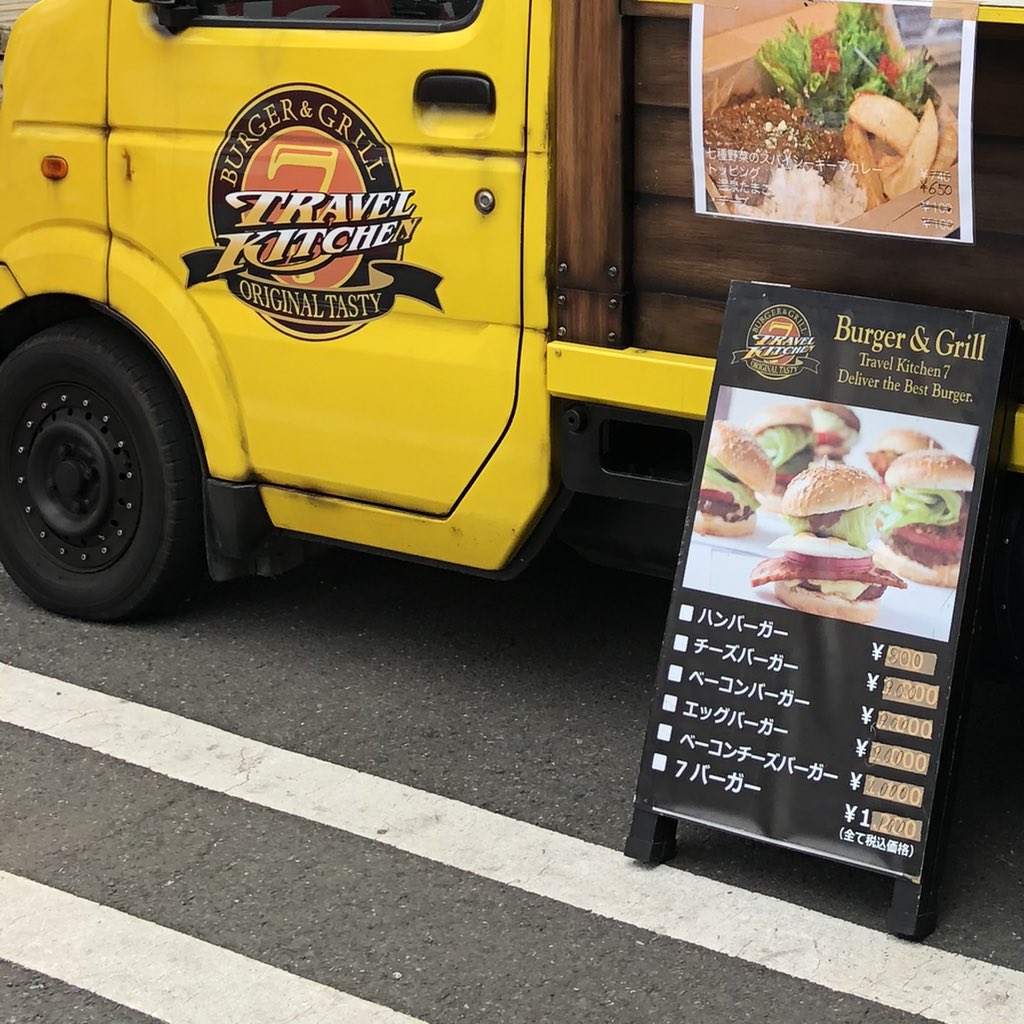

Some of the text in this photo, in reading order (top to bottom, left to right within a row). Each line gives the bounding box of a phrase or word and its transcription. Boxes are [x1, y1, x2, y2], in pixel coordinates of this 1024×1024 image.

[220, 99, 384, 187] BURGER & GRILL
[708, 163, 760, 179] トッピング
[920, 179, 953, 195] ¥650
[225, 190, 416, 227] TRAVEL
[207, 217, 422, 277] KITCHEN
[239, 279, 382, 319] ORIGINAL TASTY
[752, 335, 816, 346] TRAVEL
[834, 314, 986, 362] Burger & Grill
[859, 353, 894, 372] Travel
[837, 369, 973, 404] Deliver the Best Burger.
[697, 608, 788, 638] ハンバーガー
[693, 638, 799, 672] チーズバーガー
[688, 671, 810, 707] ベーコンバーガー
[683, 701, 788, 736] エッグバーガー
[680, 733, 838, 782] ベーコンチーズバーガー
[839, 827, 915, 858] (全て税込価格)
